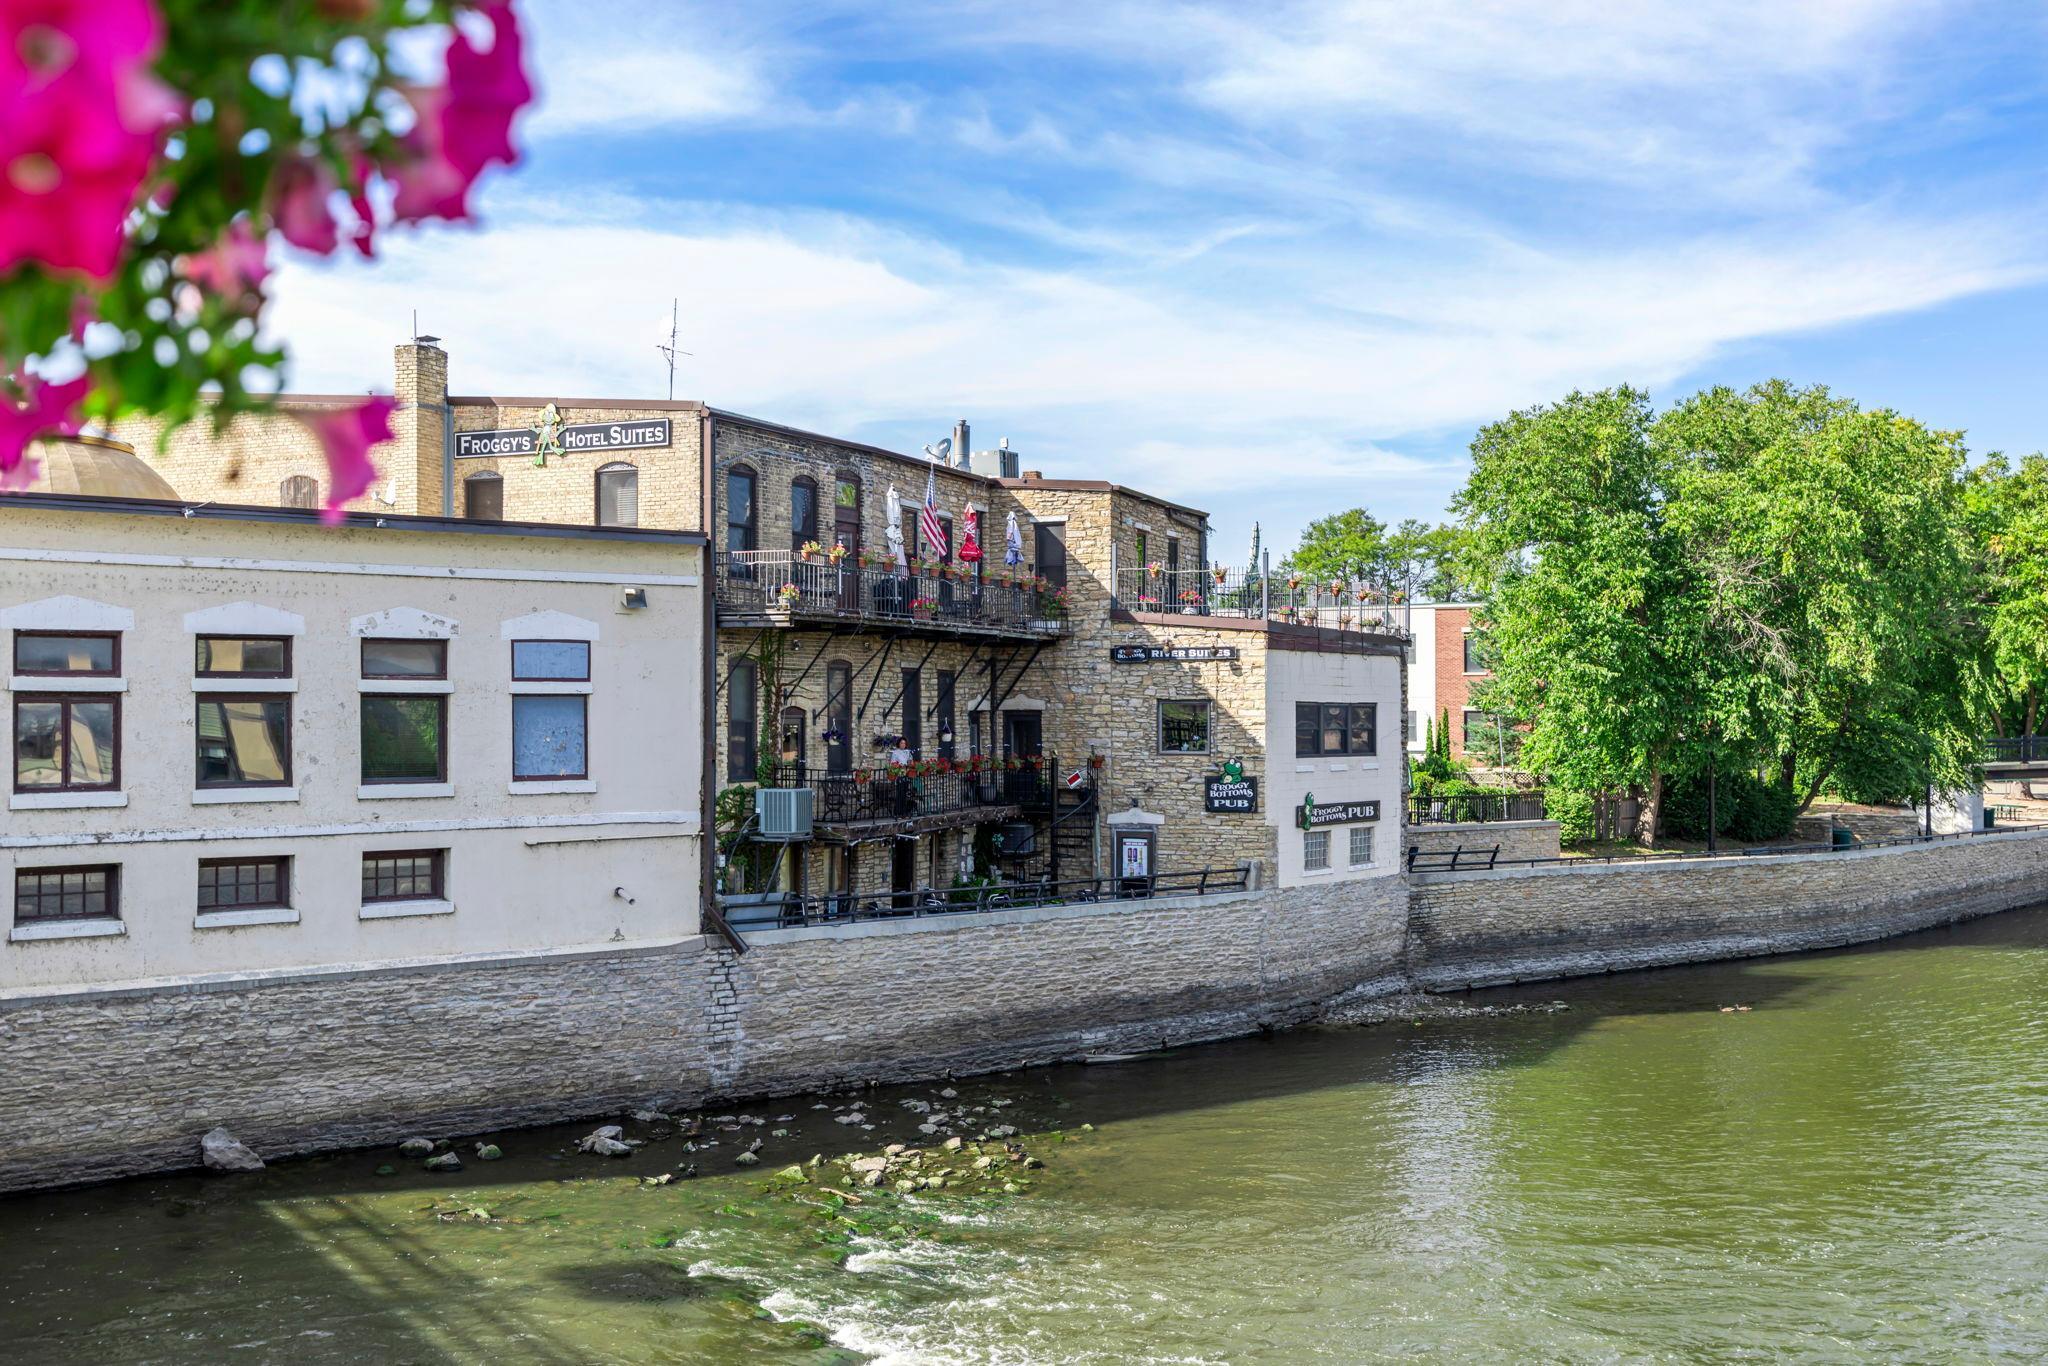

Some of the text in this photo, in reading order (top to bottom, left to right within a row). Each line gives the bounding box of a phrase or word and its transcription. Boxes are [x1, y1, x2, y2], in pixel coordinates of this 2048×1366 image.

[460, 426, 664, 454] FROGGY'S HOTEL SUITES
[1188, 648, 1231, 658] SUIES
[1210, 781, 1250, 791] FROGGY
[1210, 788, 1254, 798] BOTTOMS
[1213, 799, 1250, 808] PUB
[1312, 804, 1345, 816] FROGGY
[1348, 805, 1375, 818] PUB
[1311, 811, 1347, 823] BOTTOMS
